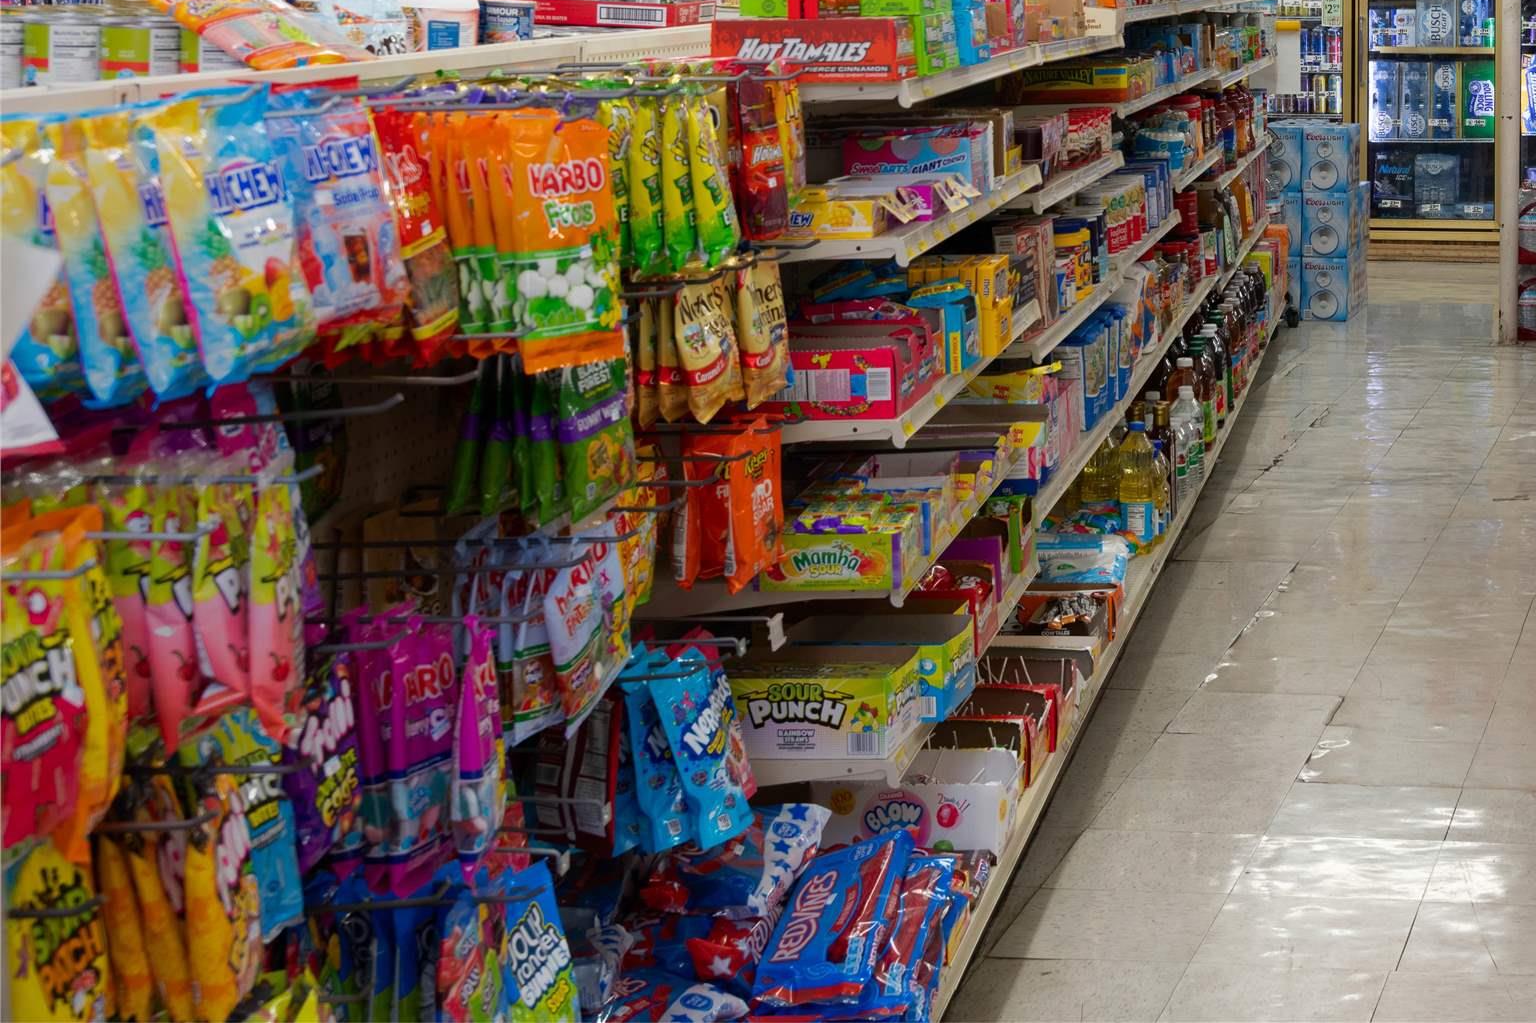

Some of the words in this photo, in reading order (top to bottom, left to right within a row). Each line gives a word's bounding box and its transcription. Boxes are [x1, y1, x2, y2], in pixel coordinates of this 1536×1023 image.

[1431, 5, 1442, 41] BUSCH
[838, 65, 888, 73] CINNAMON
[1475, 94, 1485, 112] ROCK
[1483, 84, 1494, 112] ROLLING
[1306, 132, 1327, 141] Coors
[1327, 134, 1345, 142] LIGHT
[1306, 198, 1326, 207] Coors
[1326, 199, 1345, 207] LIGHT
[1305, 262, 1326, 271] Coors
[792, 548, 861, 571] Mamba
[809, 563, 842, 576] SOUR
[767, 684, 824, 701] SOUR
[749, 699, 848, 728] PUNCH
[777, 729, 815, 738] RAINBOW
[865, 801, 923, 833] BLOW
